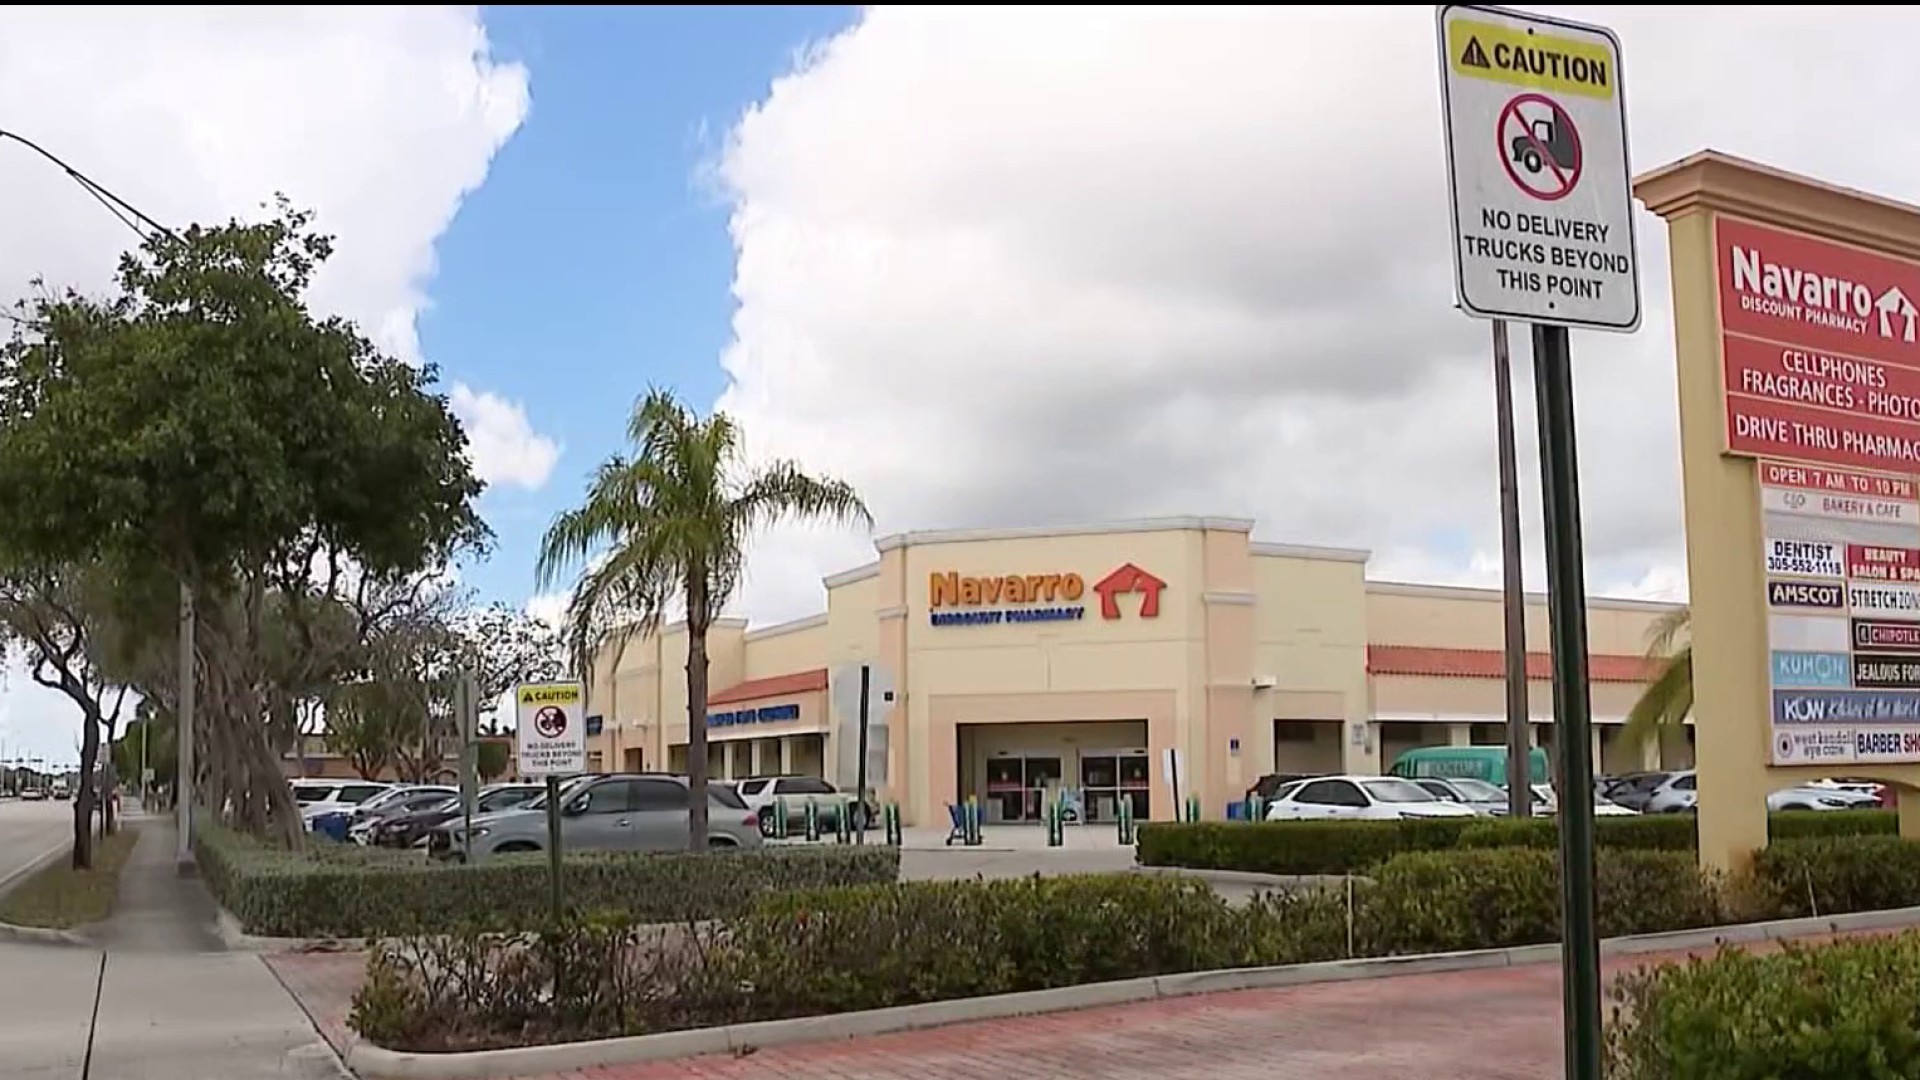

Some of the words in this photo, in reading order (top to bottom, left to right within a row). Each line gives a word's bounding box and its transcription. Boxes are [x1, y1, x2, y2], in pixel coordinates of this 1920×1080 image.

[1494, 43, 1607, 86] CAUTION
[1482, 208, 1511, 230] NO
[1517, 213, 1609, 244] DELIVERY
[1464, 235, 1545, 264] TRUCKS
[1551, 246, 1629, 274] BEYOND
[1496, 268, 1541, 292] THIS
[1547, 275, 1603, 299] POINT
[1732, 245, 1872, 318] Navarro
[1742, 296, 1802, 320] DISCOUNT
[1805, 309, 1868, 334] PHARMACY
[1782, 350, 1886, 388] CELLPHONES
[1743, 368, 1853, 408] FRAGRANCES
[1868, 392, 1920, 420] PHOTO
[1736, 413, 1788, 442] DRIVE
[1792, 421, 1838, 449] THRU
[1842, 430, 1920, 462] PHARMAC
[1769, 466, 1806, 484] OPEN
[1812, 471, 1822, 486] 7
[1826, 474, 1846, 490] AM
[1851, 477, 1869, 492] TO
[1876, 480, 1891, 495] 10
[1893, 481, 1911, 496] PM
[1823, 497, 1864, 514] BAKERY
[1876, 502, 1901, 519] CAFE
[1774, 541, 1833, 560] DENTIST
[1864, 547, 1906, 563] BEAUTY
[1851, 564, 1887, 578] SALON
[930, 570, 1085, 607] Navarro
[1773, 585, 1839, 605] AMSCOT
[1851, 589, 1896, 609] STRETCH
[1005, 606, 1085, 624] PHARMACY
[1780, 654, 1843, 679] KUMON
[1856, 663, 1900, 681] JEALOUS
[535, 691, 578, 701] CAUTION
[1784, 697, 1825, 720] KOW
[1804, 746, 1820, 759] eye
[1823, 746, 1845, 755] care
[1857, 733, 1901, 753] BARBER
